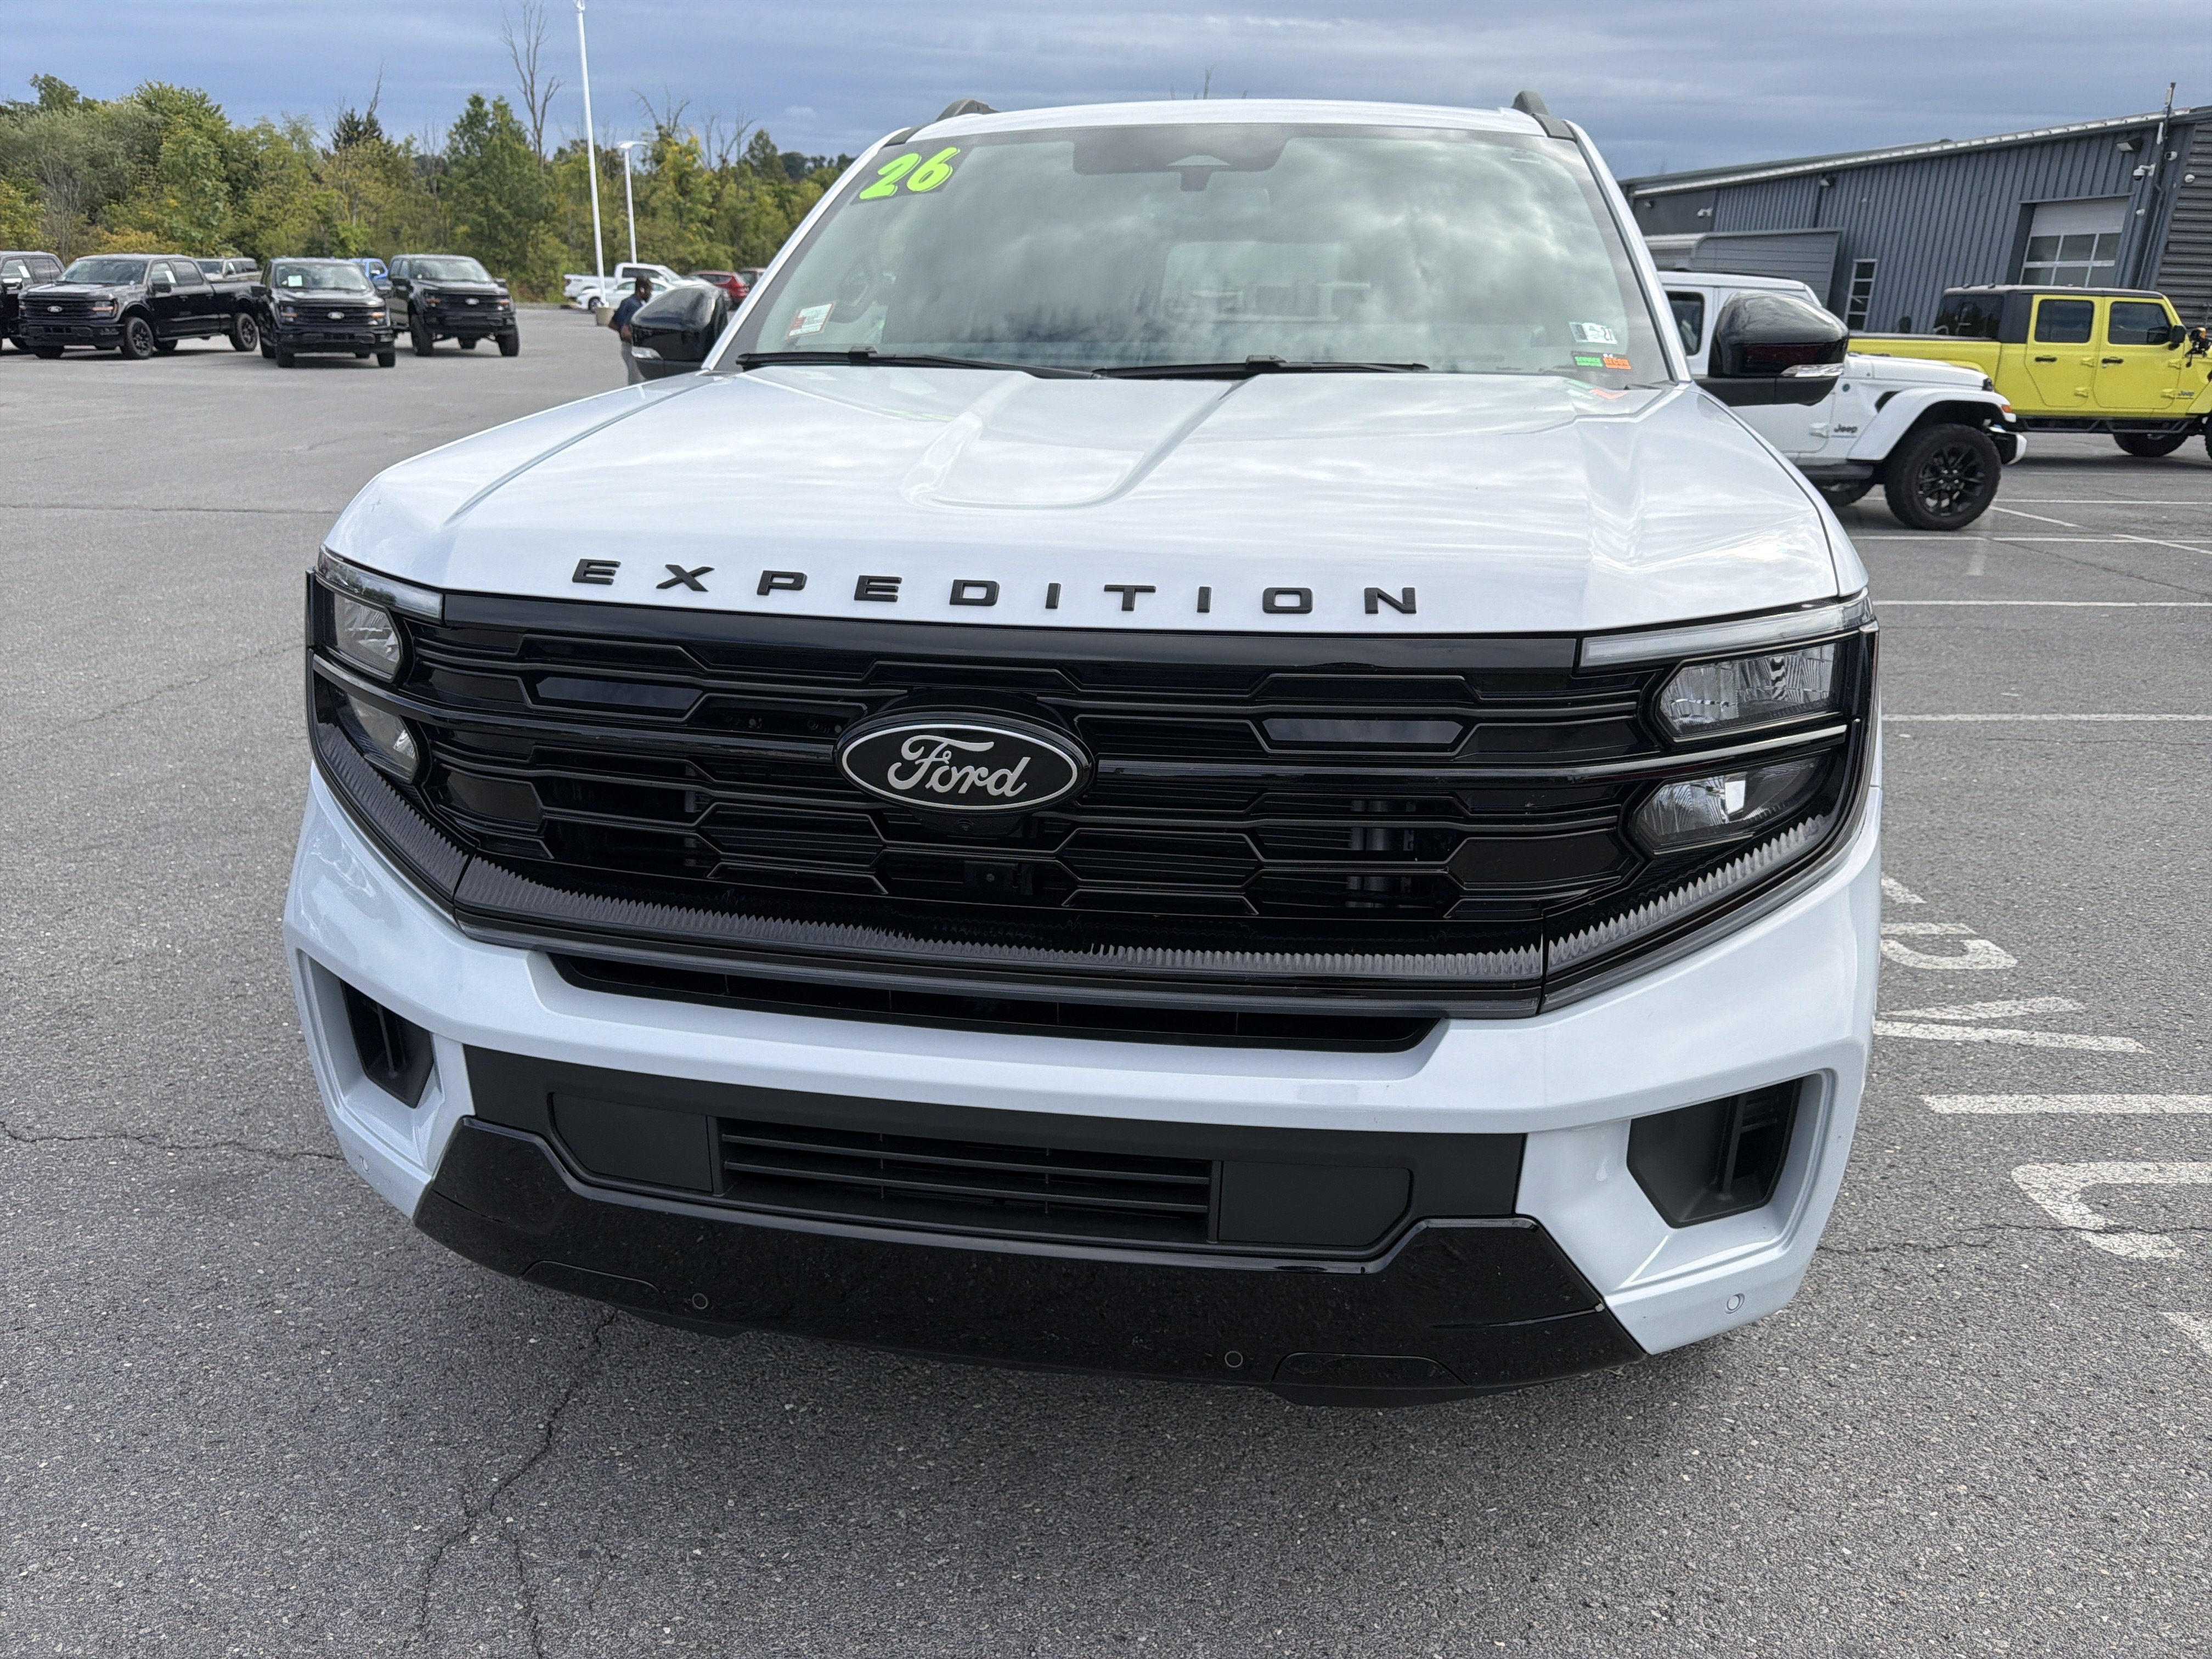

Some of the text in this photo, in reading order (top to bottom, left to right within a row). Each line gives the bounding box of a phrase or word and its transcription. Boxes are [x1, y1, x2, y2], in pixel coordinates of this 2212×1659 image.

[859, 147, 960, 200] 26
[1834, 424, 1858, 433] Jeep
[572, 558, 1417, 614] EXPEDITION
[887, 735, 1031, 797] Ford
